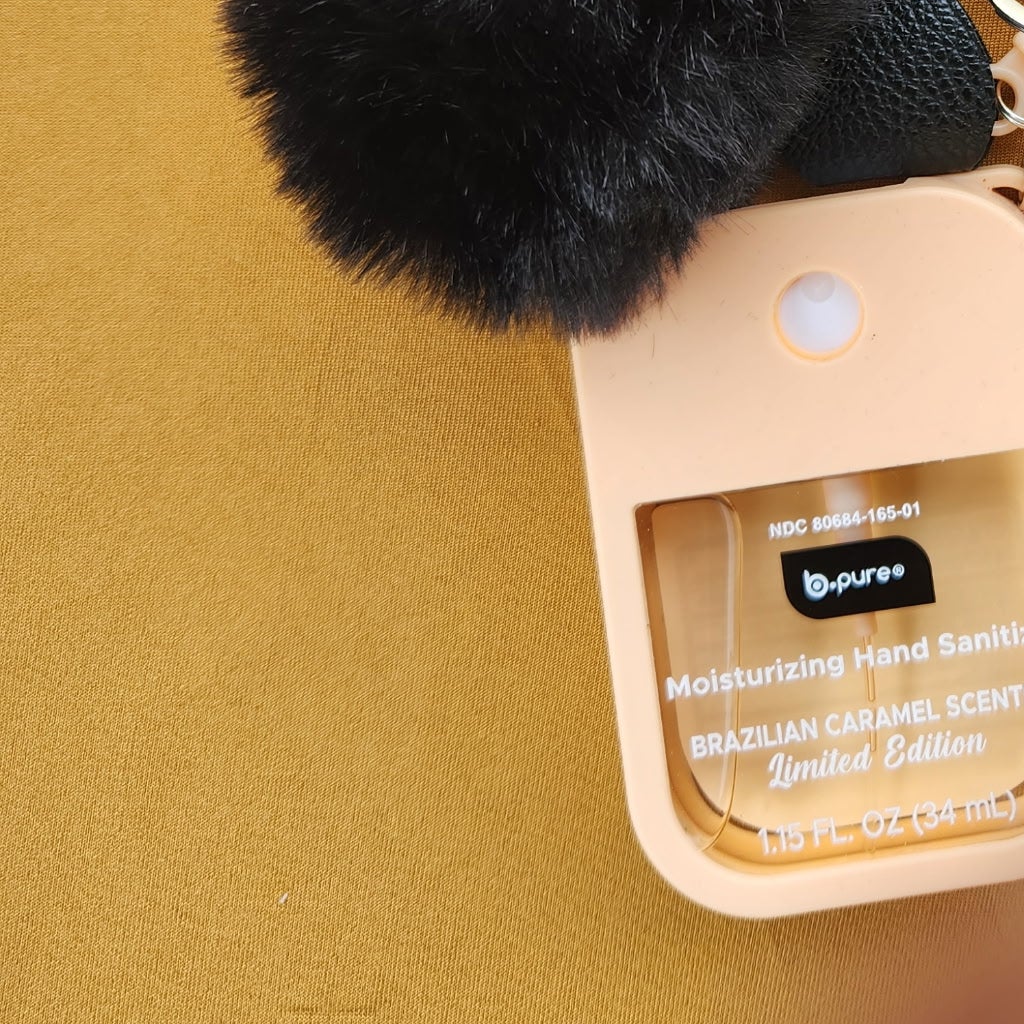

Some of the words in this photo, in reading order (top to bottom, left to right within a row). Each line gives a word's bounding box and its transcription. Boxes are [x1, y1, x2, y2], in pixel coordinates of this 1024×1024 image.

[768, 519, 807, 540] NDC
[812, 501, 921, 533] 80684-165-01
[666, 654, 845, 700] Moisturizing
[854, 636, 929, 669] Hand
[691, 717, 819, 759] BRAZILIAN
[825, 698, 940, 736] CARAMEL
[768, 743, 872, 789] Limited
[883, 731, 987, 769] Edition
[757, 823, 804, 855] 1.15
[812, 817, 854, 847] FL.
[861, 806, 904, 838] OZ
[911, 798, 956, 835] (34
[965, 789, 1017, 822] mL)
